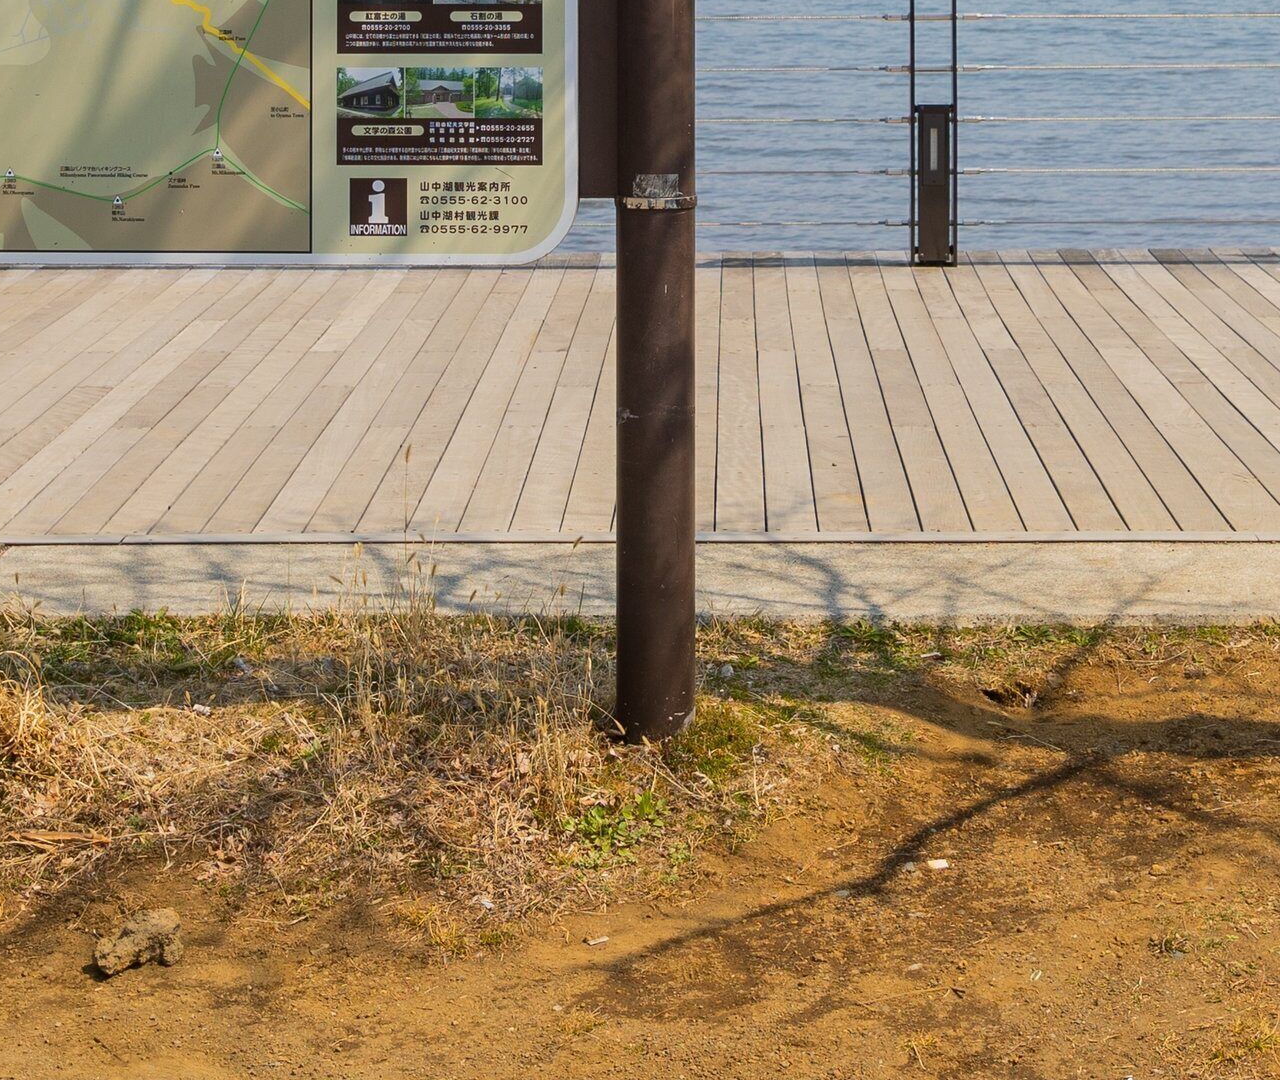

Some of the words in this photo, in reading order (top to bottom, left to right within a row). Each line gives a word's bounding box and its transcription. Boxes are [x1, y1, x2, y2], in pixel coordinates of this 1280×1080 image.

[365, 12, 406, 20] 紅富士の湯
[470, 12, 503, 20] 石割の湯
[363, 126, 412, 135] 文学の森公園
[420, 181, 511, 192] 山中湖観光案内所
[420, 210, 499, 221] 山中湖村観光課
[350, 224, 407, 235] INFORMATION
